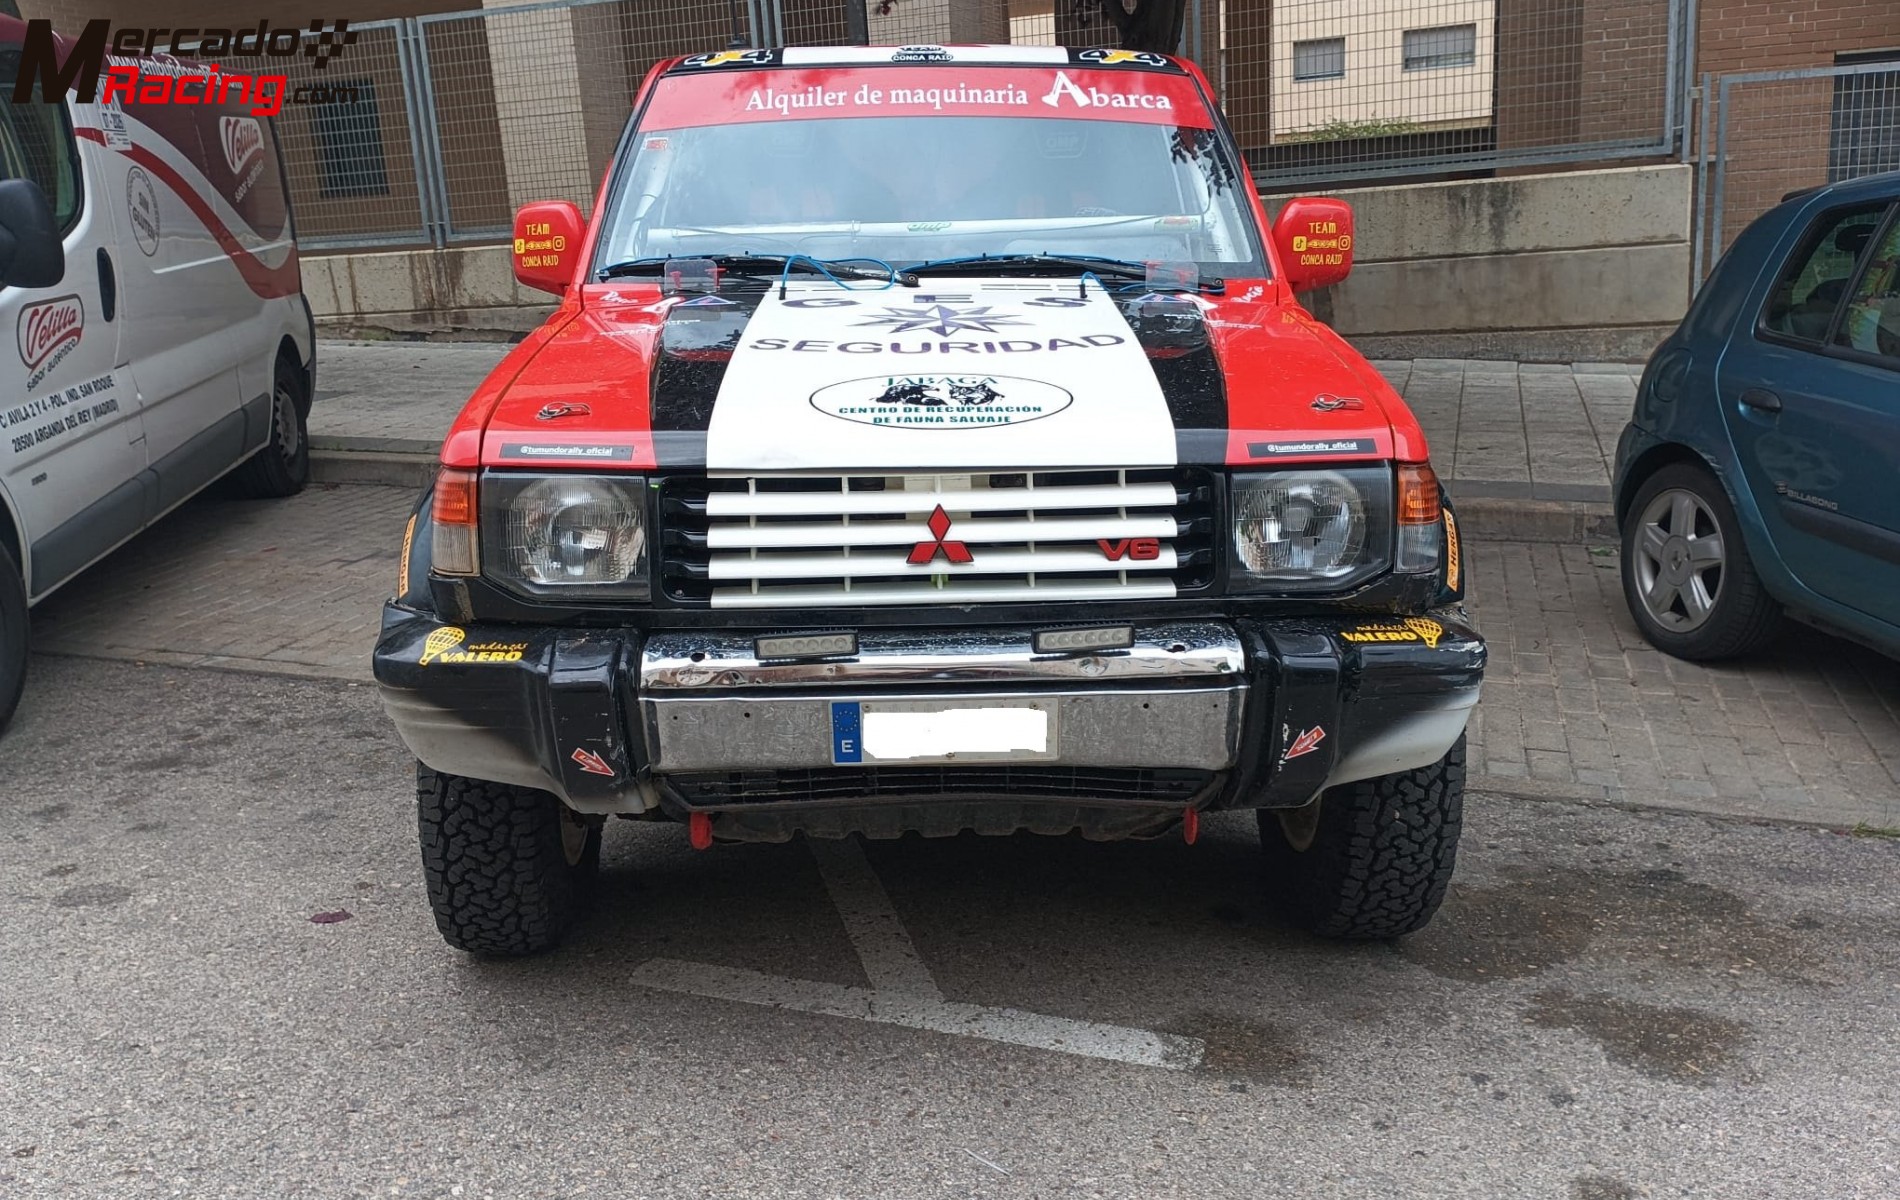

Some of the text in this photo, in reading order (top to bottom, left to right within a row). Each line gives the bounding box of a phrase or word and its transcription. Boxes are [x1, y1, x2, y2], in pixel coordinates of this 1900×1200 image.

[746, 70, 1173, 115] Alquiler de maquinaria Abarca
[526, 223, 550, 235] TEAM
[1308, 222, 1337, 234] TEAM
[522, 255, 559, 267] CONCA RAID
[1300, 254, 1343, 266] CONCA RAID
[26, 305, 77, 359] Velilla
[749, 333, 1126, 355] SEGURIDAD
[882, 376, 999, 387] JABAGA
[8, 406, 31, 426] AVILA
[29, 403, 37, 418] 2
[34, 400, 42, 415] Y
[41, 398, 48, 411] 4
[79, 382, 94, 398] SAN
[92, 374, 115, 393] ROQUE
[838, 406, 899, 414] CENTRO
[926, 405, 1043, 413] RECUPERACIÓN
[872, 416, 892, 424] DE
[949, 415, 1012, 423] SALVAJE
[12, 432, 35, 453] 28500
[34, 419, 67, 444] ARGANDA
[65, 414, 79, 430] DEL
[77, 408, 92, 425] REY
[520, 446, 613, 457] @tumundorally_oficial
[1267, 441, 1358, 453] @tumundorally_oficial
[1787, 489, 1839, 510] BILLABONG
[1096, 537, 1160, 561] V6
[1340, 631, 1418, 642] VALERO
[440, 651, 523, 663] VALERO
[841, 739, 854, 753] E
